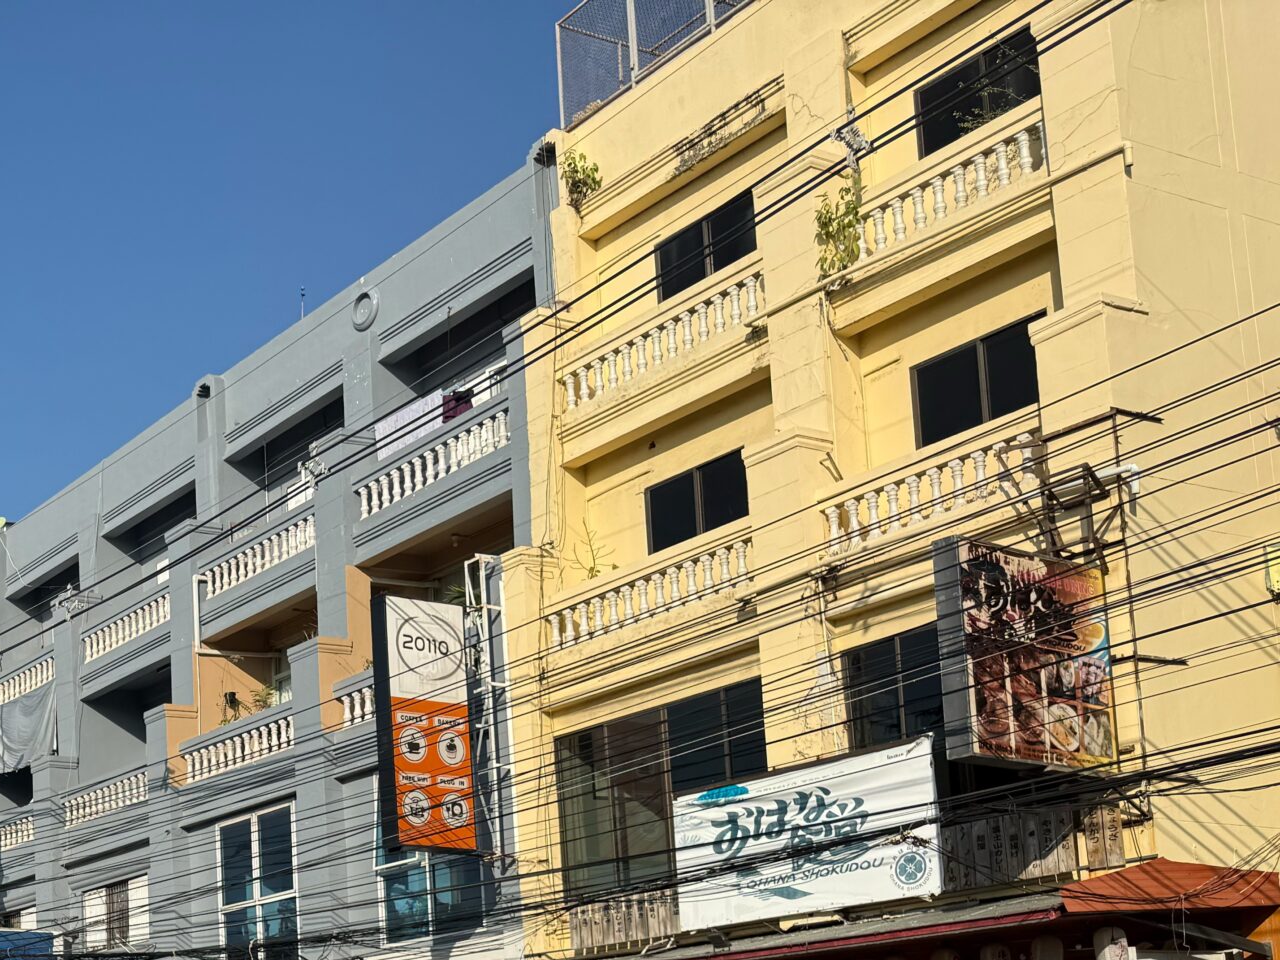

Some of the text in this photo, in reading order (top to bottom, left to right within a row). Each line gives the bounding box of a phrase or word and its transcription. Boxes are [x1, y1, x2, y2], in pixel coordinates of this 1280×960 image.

[402, 634, 449, 656] 20110
[746, 857, 884, 889] OHANA SHOKUDOU
